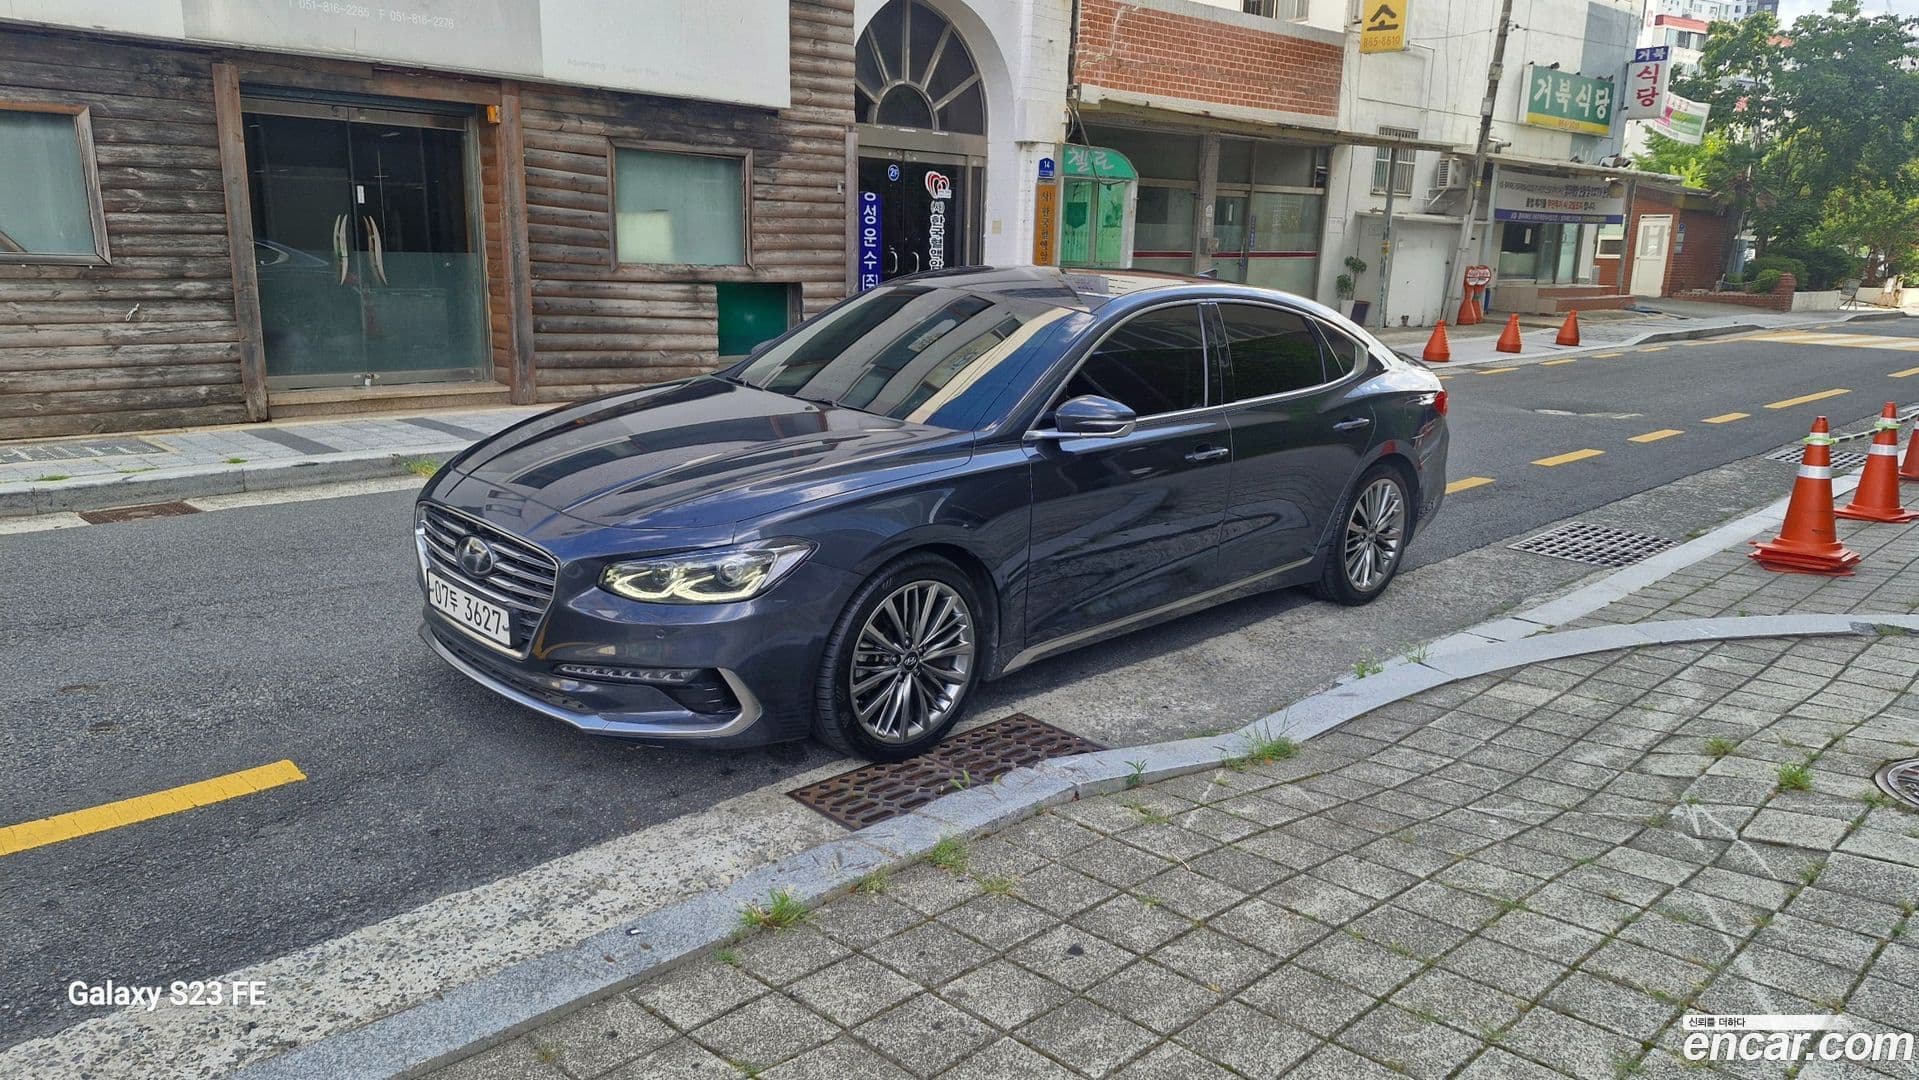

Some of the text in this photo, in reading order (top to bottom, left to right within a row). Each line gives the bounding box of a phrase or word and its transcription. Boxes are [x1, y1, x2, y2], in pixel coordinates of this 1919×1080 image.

[1367, 4, 1398, 31] 소
[1637, 47, 1666, 60] 거북
[1534, 74, 1610, 119] 거북식당
[1636, 64, 1659, 107] 식당
[464, 596, 501, 635] 3627
